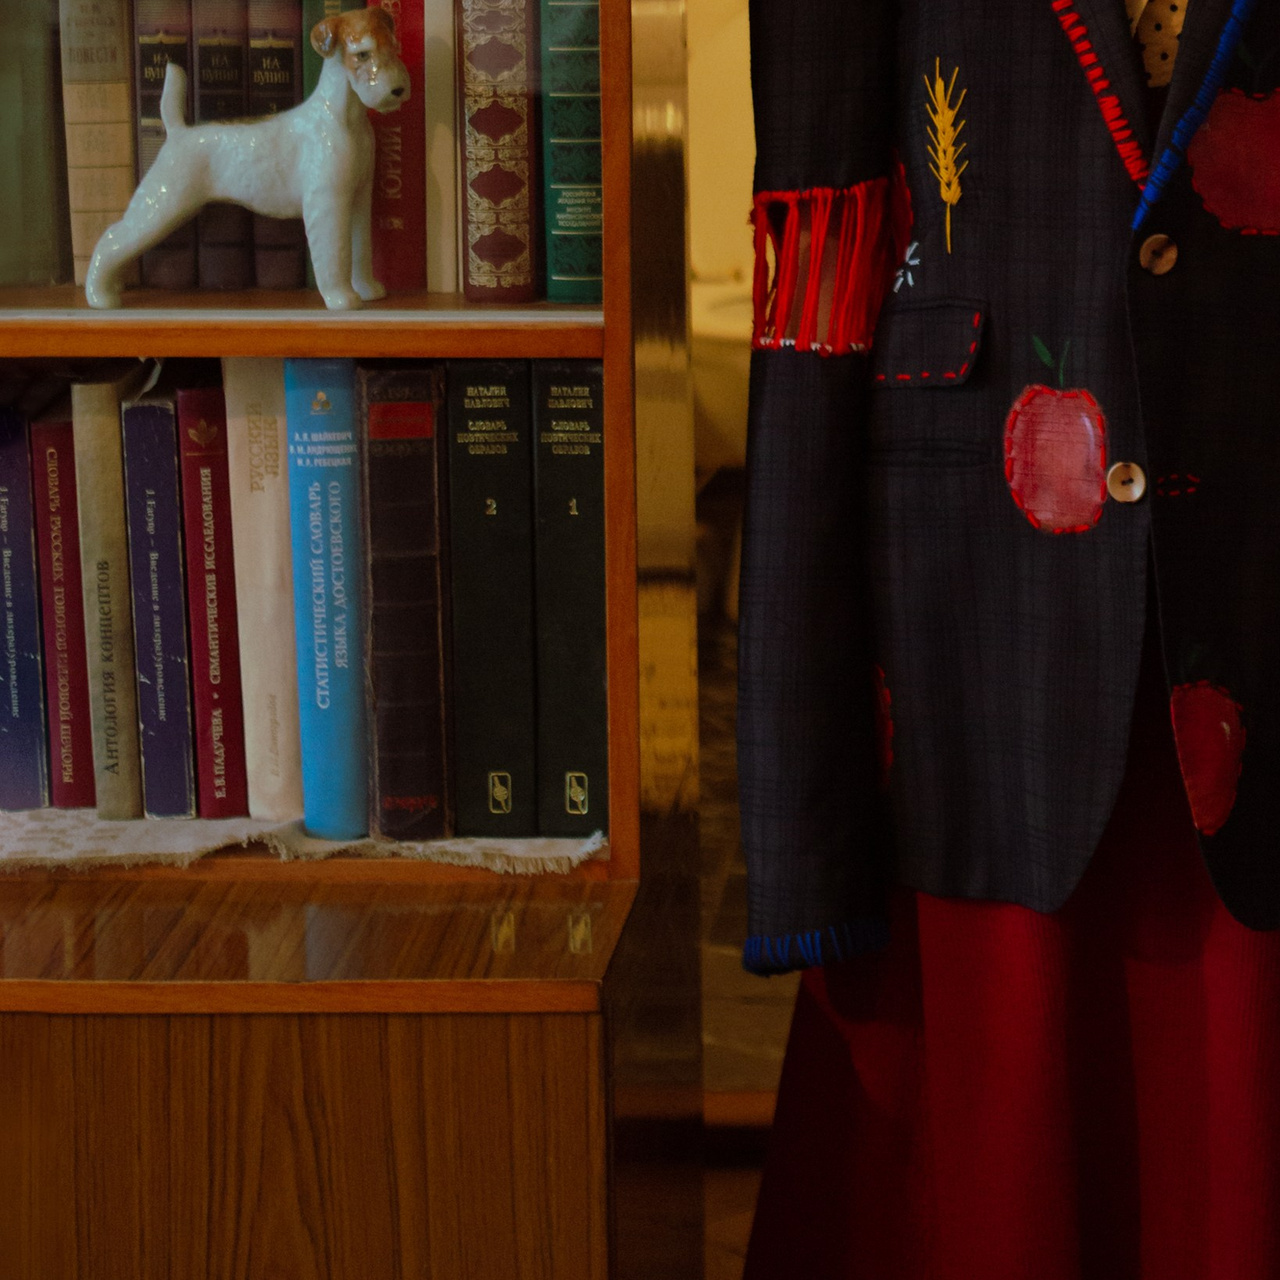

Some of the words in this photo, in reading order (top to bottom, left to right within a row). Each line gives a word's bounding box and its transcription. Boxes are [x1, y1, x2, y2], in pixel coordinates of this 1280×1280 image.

[379, 126, 403, 199] ЮРИЙ
[46, 446, 61, 511] СЛОВАРЬ
[247, 403, 266, 493] РУССКИЙ
[264, 416, 279, 477] ЯЗЫК
[199, 467, 216, 570] ИССЛЕДОВАНИЯ
[308, 481, 326, 554] СЛОВАРЬ
[484, 497, 498, 516] 2
[567, 497, 579, 516] 1
[50, 515, 65, 583] РУССКИХ
[328, 481, 347, 610] ДОСТОЕВСКОГО
[53, 586, 69, 651] ГОВОРОВ
[205, 574, 222, 685] СЕМАНТИЧЕСКИЕ
[309, 558, 331, 709] СТАТИСТИЧЕСКИЙ
[333, 613, 349, 668] ЯЗЫКА
[59, 724, 75, 783] ПЕЧОРЫ
[98, 671, 120, 777] Антология
